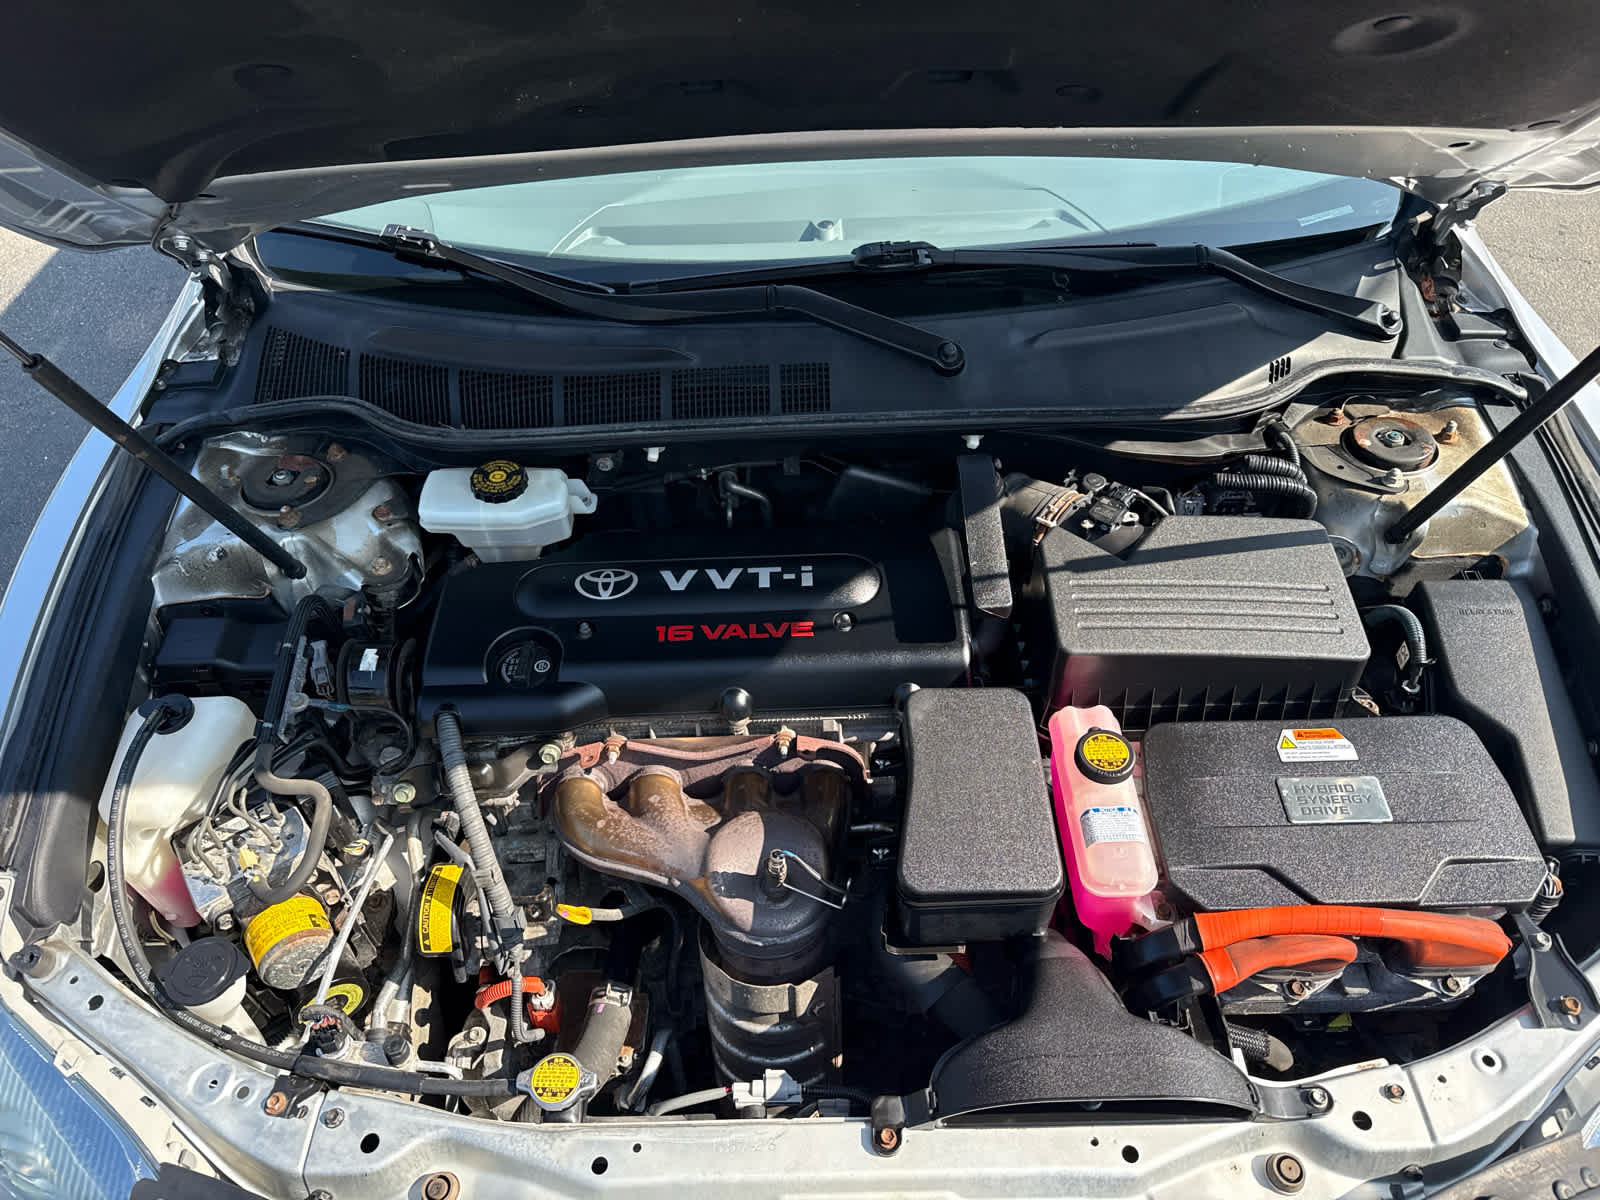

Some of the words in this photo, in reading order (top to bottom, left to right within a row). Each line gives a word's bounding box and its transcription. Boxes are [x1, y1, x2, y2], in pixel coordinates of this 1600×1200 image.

[659, 565, 814, 591] VVT-i
[656, 625, 694, 642] 16
[700, 621, 814, 640] VALVE
[1294, 784, 1355, 794] HYBRID
[1296, 794, 1371, 805] SYNERGY
[1301, 806, 1350, 816] DRIVE
[422, 902, 431, 934] CAUTION
